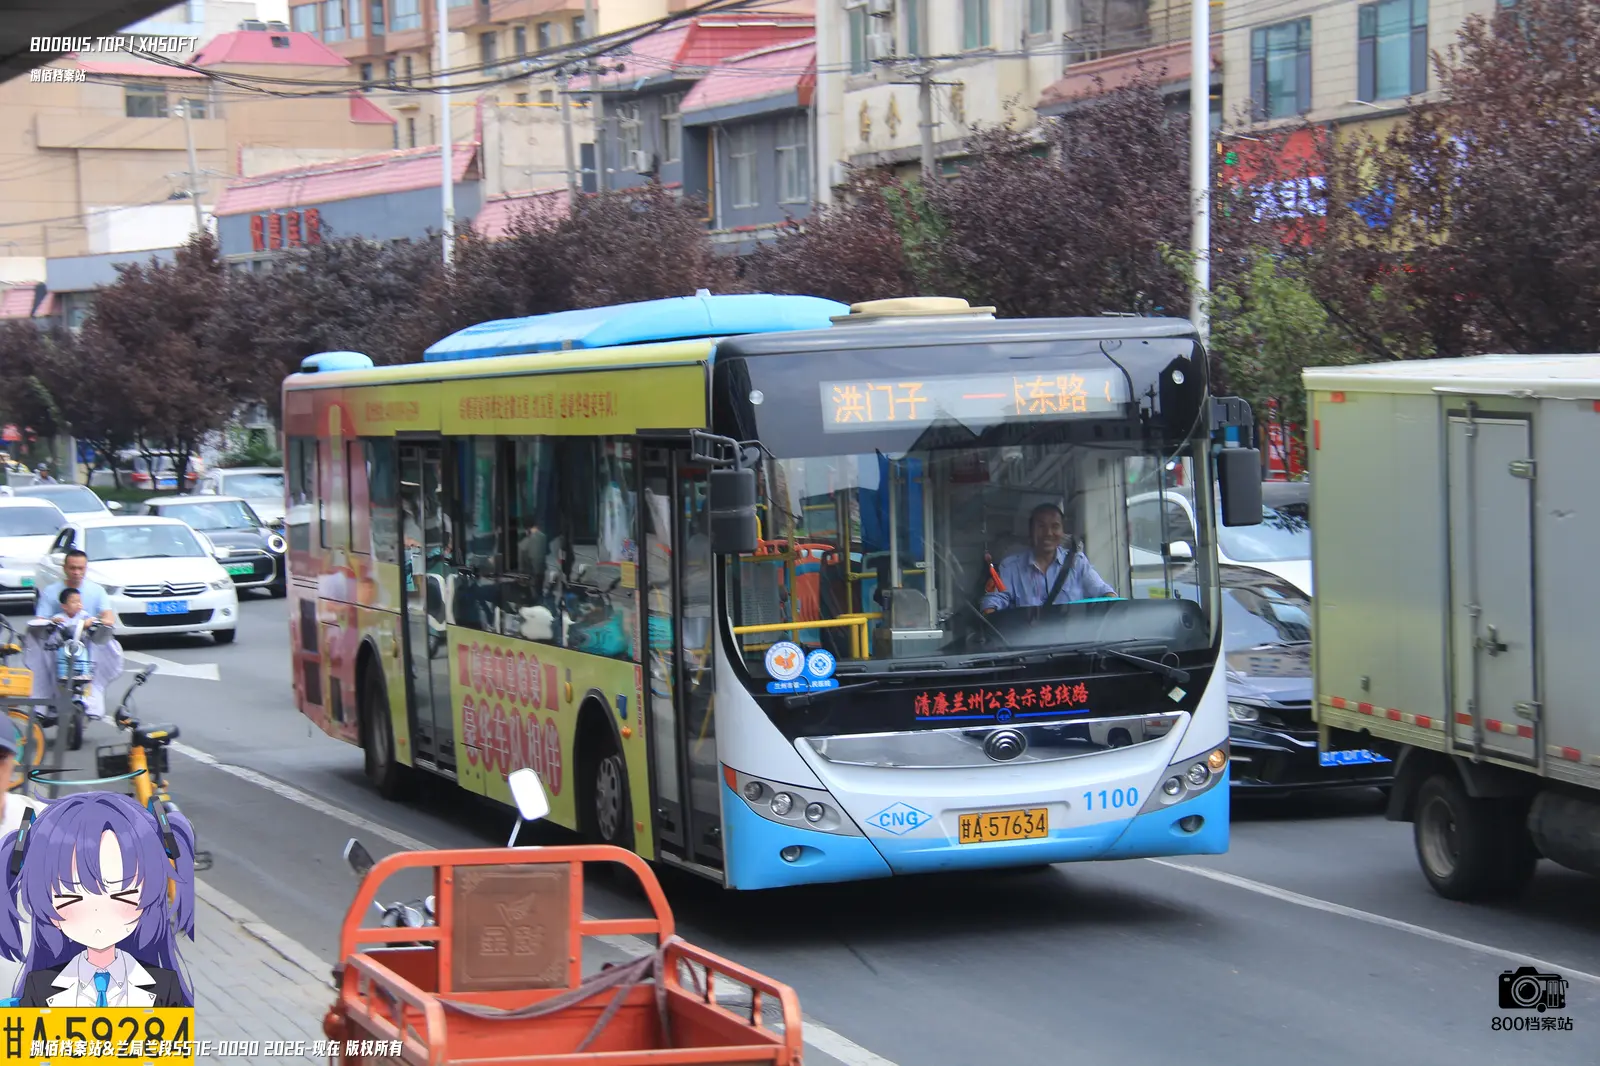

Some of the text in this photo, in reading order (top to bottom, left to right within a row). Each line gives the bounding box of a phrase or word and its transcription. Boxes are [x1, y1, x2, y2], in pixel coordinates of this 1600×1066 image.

[832, 382, 928, 423] 洪门子
[914, 682, 1089, 716] 清廉兰州公交示范线路
[463, 701, 561, 787] 豪华车队相伴
[1083, 787, 1139, 811] 1100
[879, 810, 919, 827] CNG
